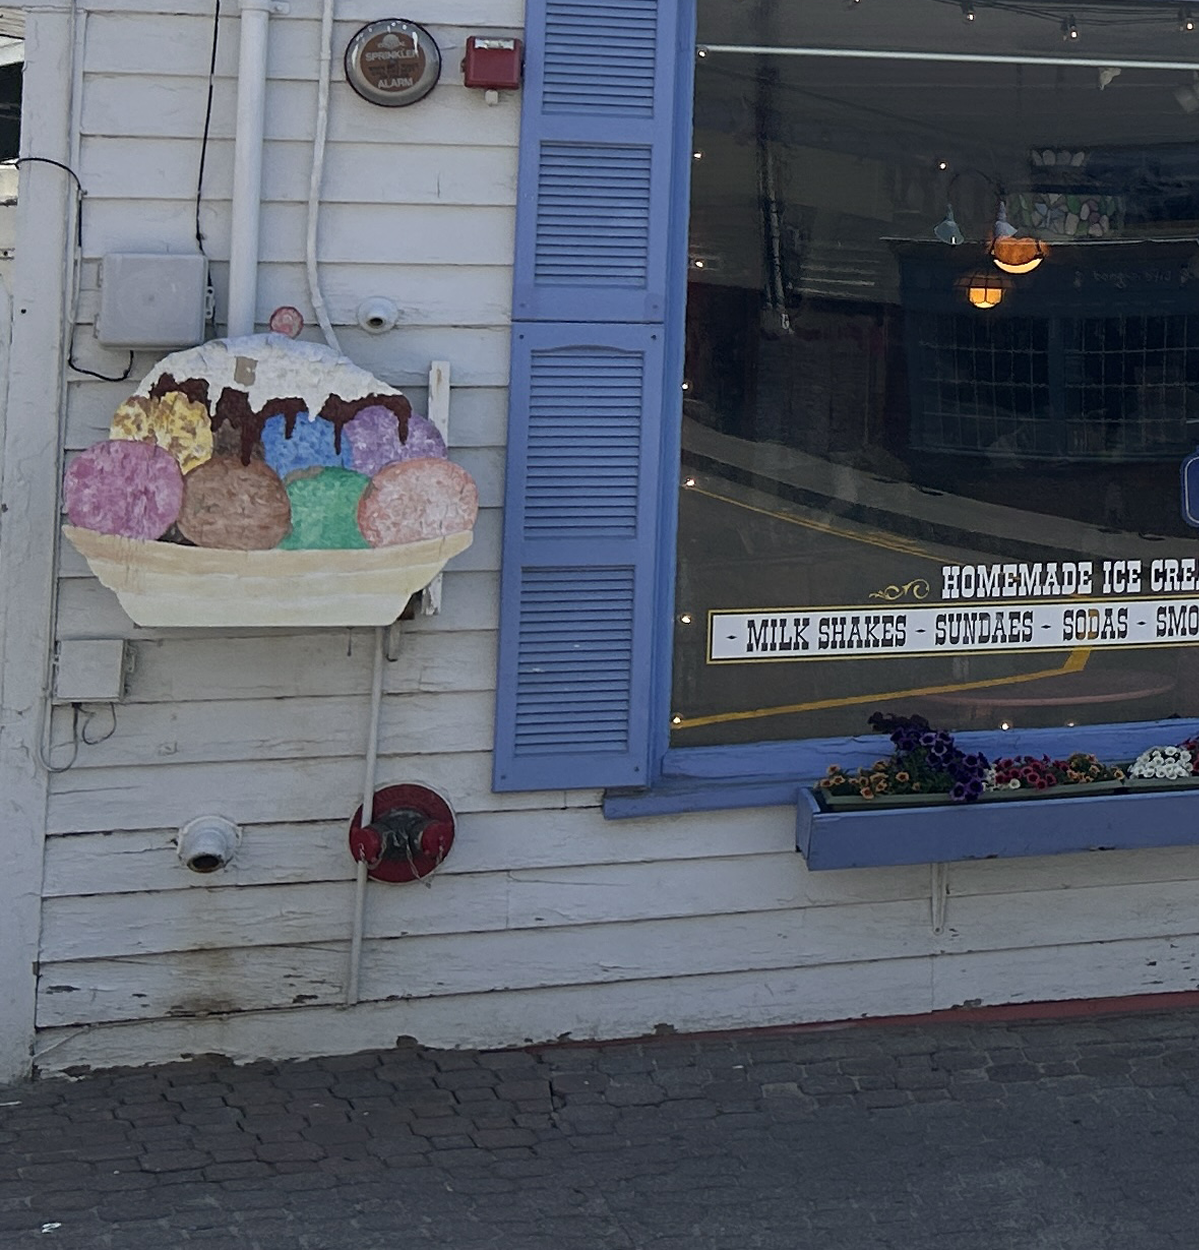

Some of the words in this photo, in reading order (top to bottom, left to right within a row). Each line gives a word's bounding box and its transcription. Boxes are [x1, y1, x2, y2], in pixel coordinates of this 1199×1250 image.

[378, 77, 413, 89] ALARM
[941, 562, 1092, 600] HOMEMADE
[1102, 560, 1142, 595] ICE
[746, 617, 810, 652] MILK
[818, 614, 907, 650] SHAKES
[934, 610, 1034, 646] SUNDAES
[1062, 607, 1128, 642] SODAS
